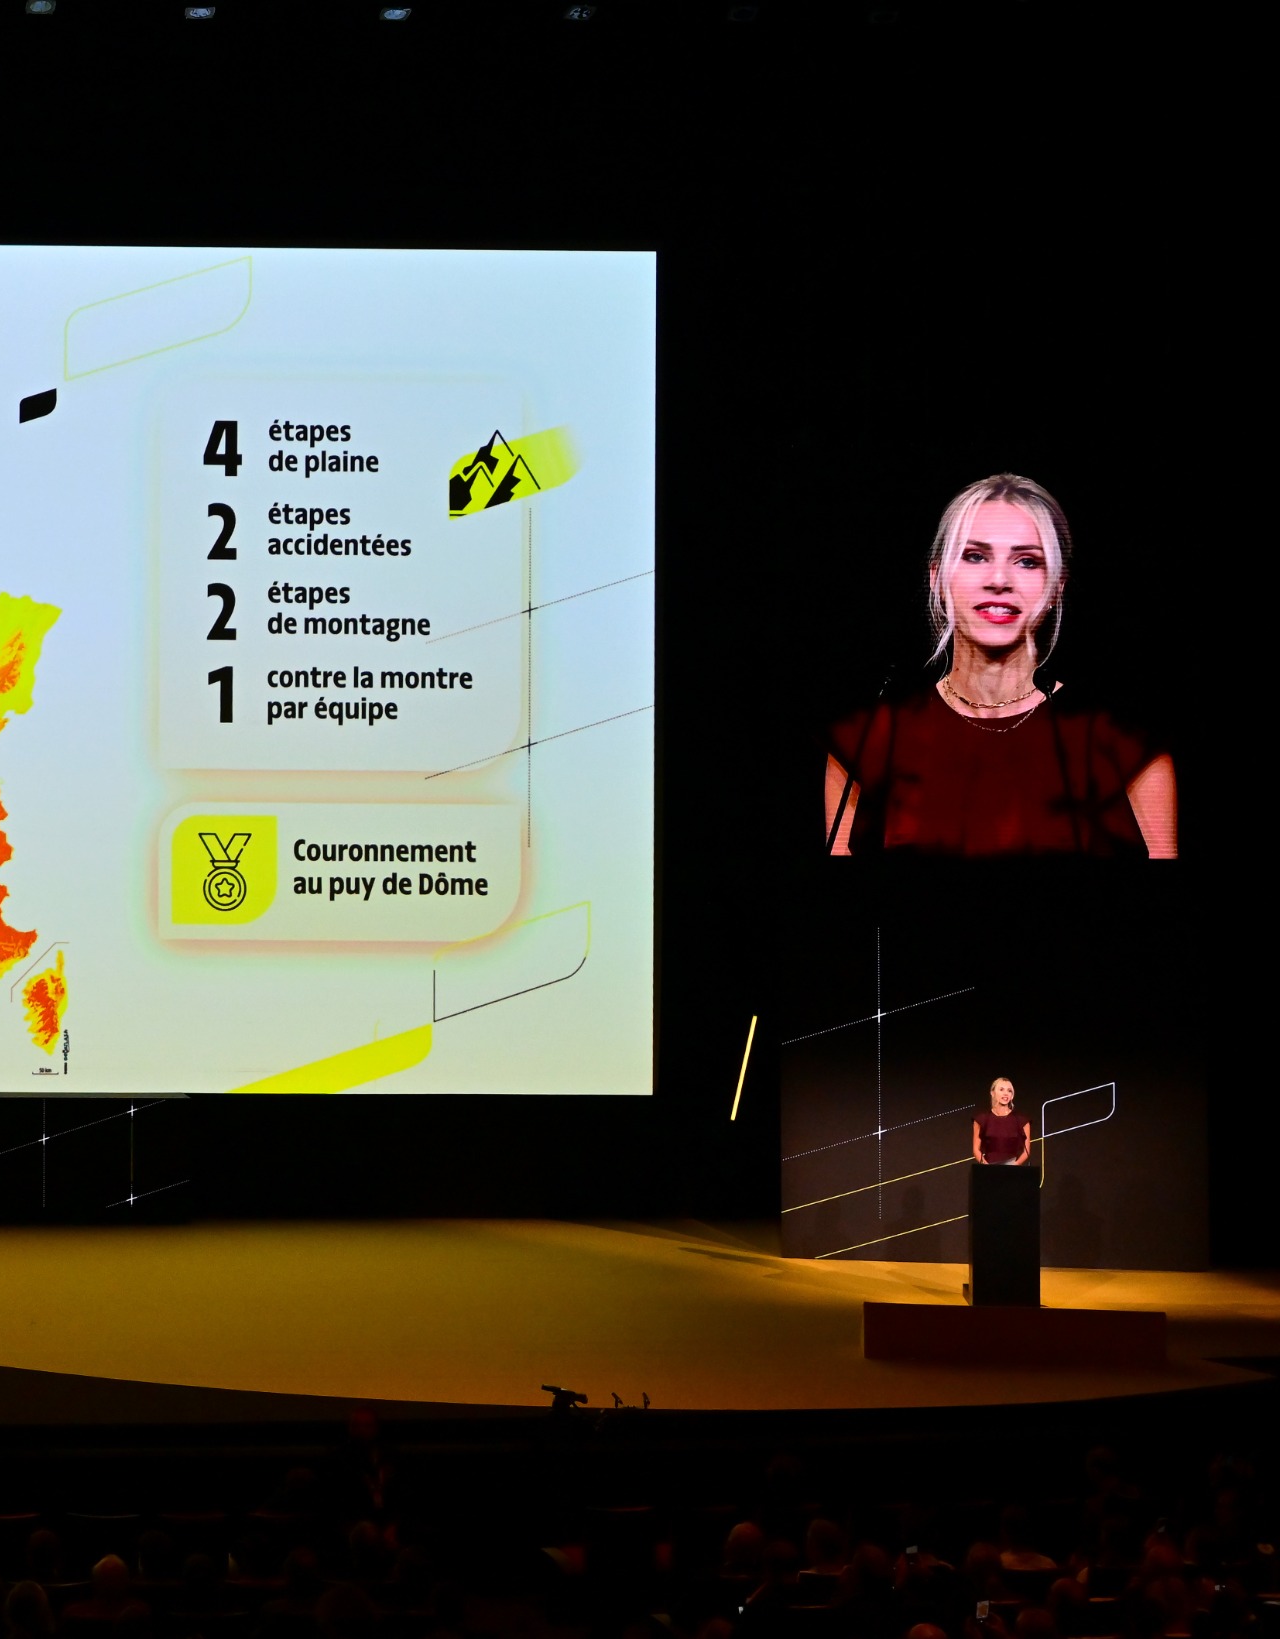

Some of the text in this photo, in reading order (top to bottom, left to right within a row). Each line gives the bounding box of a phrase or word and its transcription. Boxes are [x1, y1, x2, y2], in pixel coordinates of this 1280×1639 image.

[269, 420, 350, 447] étapes
[204, 421, 242, 476] 4
[269, 451, 378, 478] de plaine
[207, 503, 236, 560] 2
[269, 503, 350, 533] étapes
[268, 534, 411, 556] accidentées
[268, 581, 350, 610] étapes
[207, 583, 236, 640] 2
[268, 613, 430, 642] de montagne
[268, 667, 472, 689] contre la montre
[208, 666, 233, 723] 1
[268, 697, 397, 725] par équipe
[294, 839, 476, 862] Couronnement
[294, 873, 487, 901] au puy de Dôme
